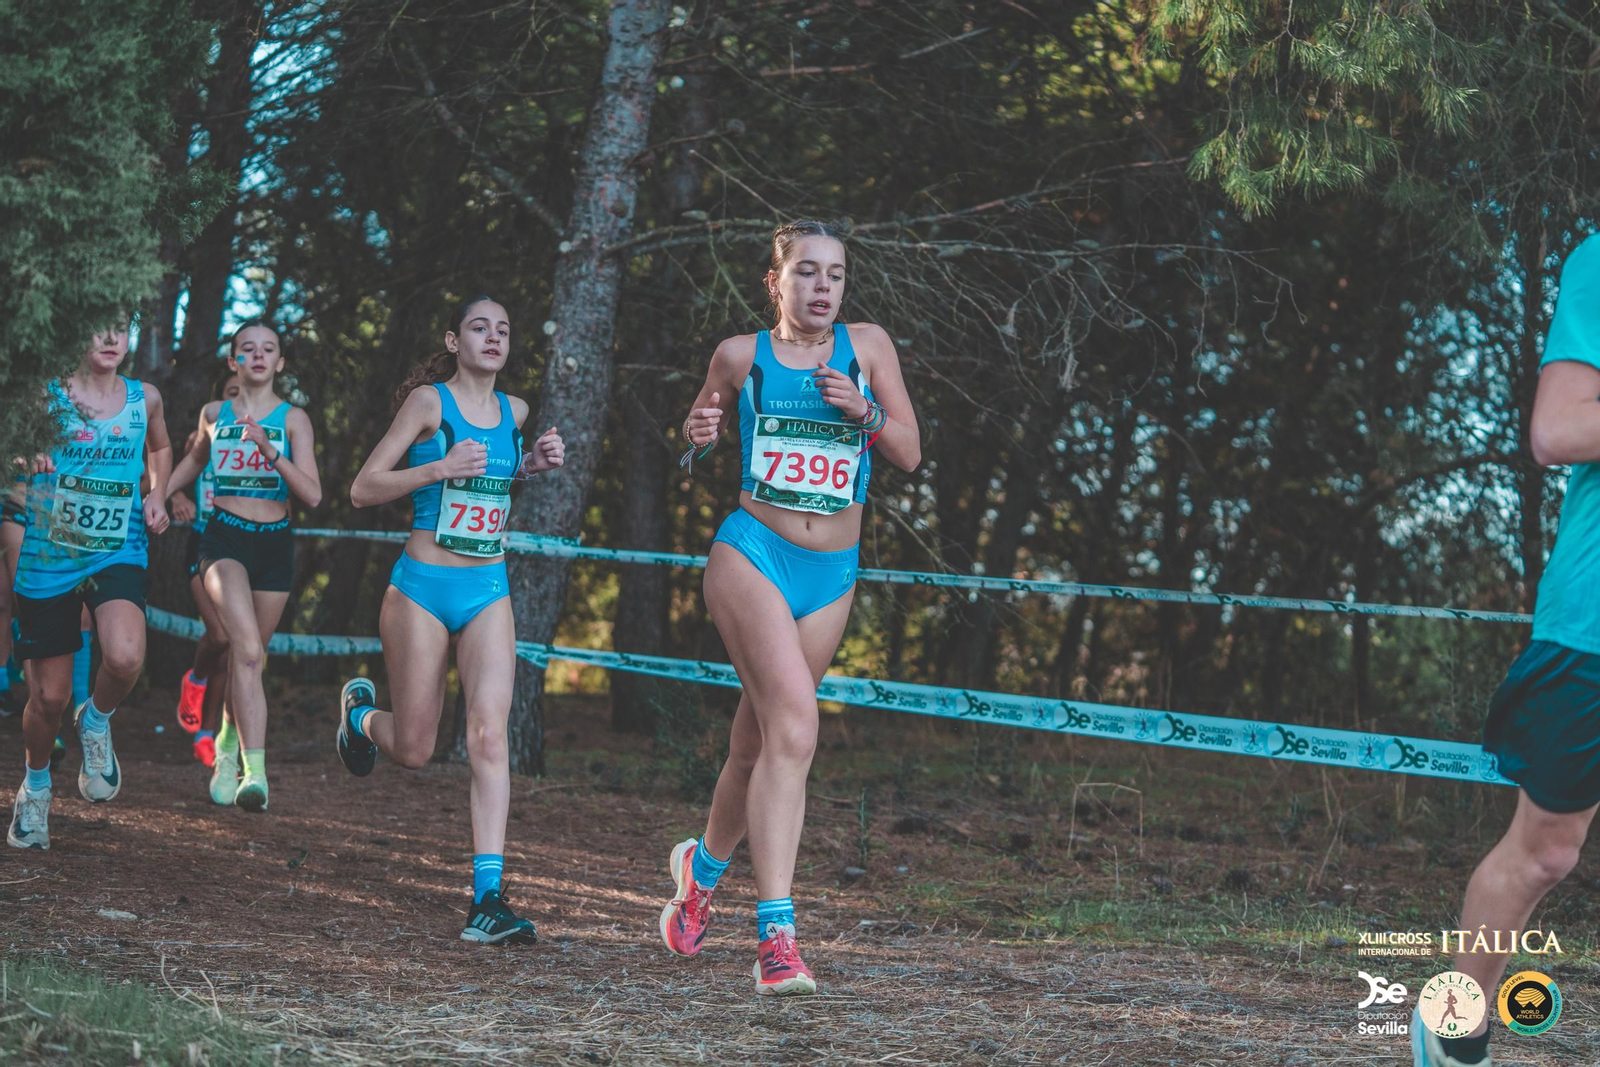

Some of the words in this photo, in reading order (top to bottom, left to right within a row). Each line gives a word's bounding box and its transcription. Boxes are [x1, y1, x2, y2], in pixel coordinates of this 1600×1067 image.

[768, 400, 838, 409] TROTASIE
[786, 420, 835, 436] ITÁLICA
[61, 447, 136, 460] MARACENA
[762, 451, 851, 490] 7396
[81, 478, 119, 493] ITÁLICA
[471, 477, 505, 491] ITÁLIC
[60, 501, 125, 531] 5825
[217, 511, 258, 532] NIKE
[449, 502, 507, 534] 7391
[1092, 720, 1125, 735] Sevilla
[1198, 733, 1232, 748] Sevilla
[1311, 736, 1349, 748] Diputación
[1310, 746, 1347, 761] Sevilla
[1431, 749, 1471, 761] Diputación
[1430, 759, 1469, 775] Sevilla
